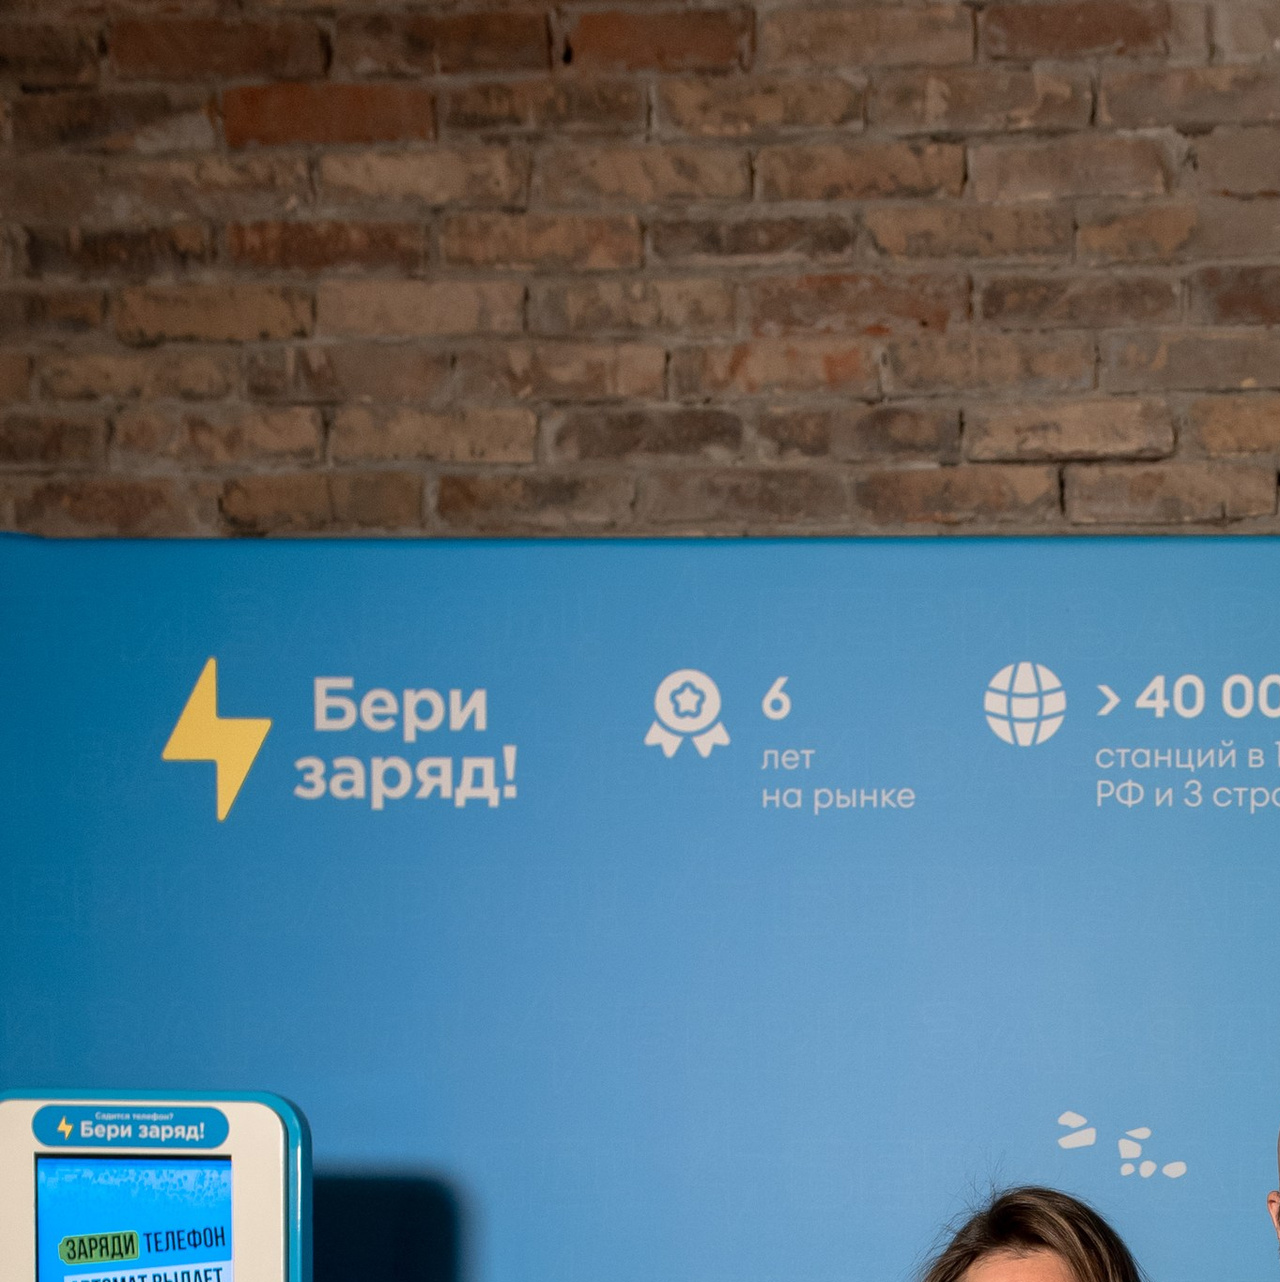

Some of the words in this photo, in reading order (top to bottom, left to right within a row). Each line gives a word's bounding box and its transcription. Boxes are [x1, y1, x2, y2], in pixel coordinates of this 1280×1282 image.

[312, 675, 488, 743] Бери
[760, 675, 793, 722] 6
[1134, 672, 1204, 720] 40
[761, 746, 816, 772] лет
[1094, 739, 1237, 773] станций
[1247, 747, 1264, 770] в
[292, 743, 519, 812] заряд!
[1095, 778, 1146, 810] РФ
[1154, 785, 1174, 808] и
[1182, 779, 1203, 808] 3
[761, 785, 803, 811] на
[813, 784, 917, 816] рынке
[80, 1120, 132, 1142] Бери
[138, 1122, 205, 1143] заряд!
[65, 1233, 136, 1260] ЗАРЯДИ
[143, 1225, 226, 1253] ТЕЛЕФОН
